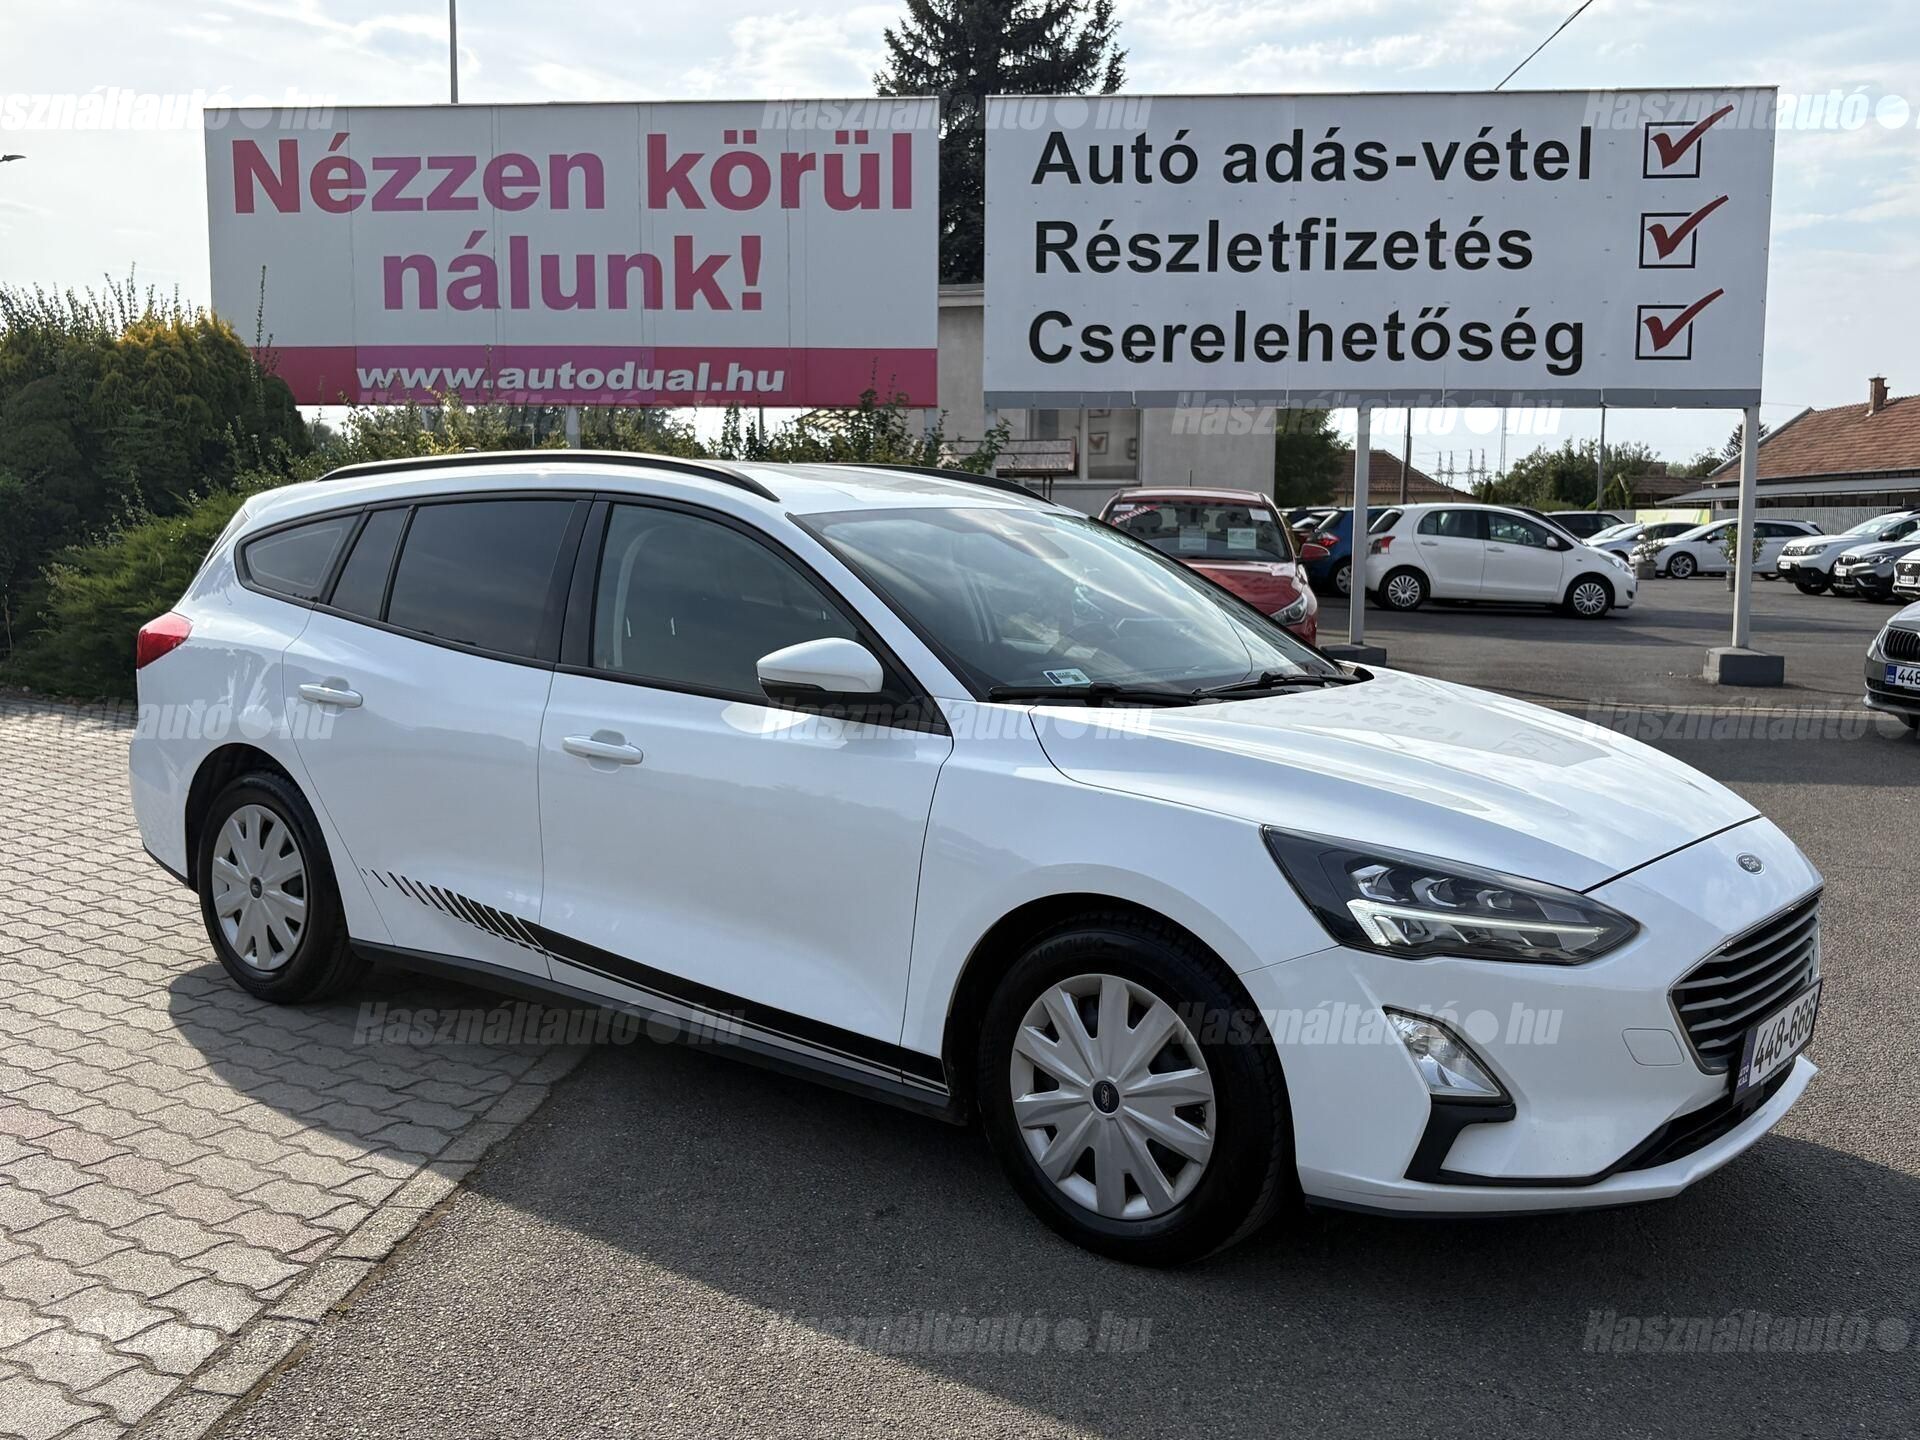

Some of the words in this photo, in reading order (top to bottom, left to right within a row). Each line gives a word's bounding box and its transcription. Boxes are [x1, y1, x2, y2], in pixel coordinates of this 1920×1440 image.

[232, 132, 605, 214] Nézzen
[647, 129, 912, 212] körül
[1031, 129, 1198, 184] Autó
[1222, 126, 1591, 183] adás-vétel
[383, 230, 763, 311] nálunk!
[1035, 216, 1533, 273] Részletfizetés
[1029, 306, 1583, 376] Cserelehetőség
[356, 360, 785, 393] www.autodual.hu
[1754, 992, 1817, 1074] 448-666
